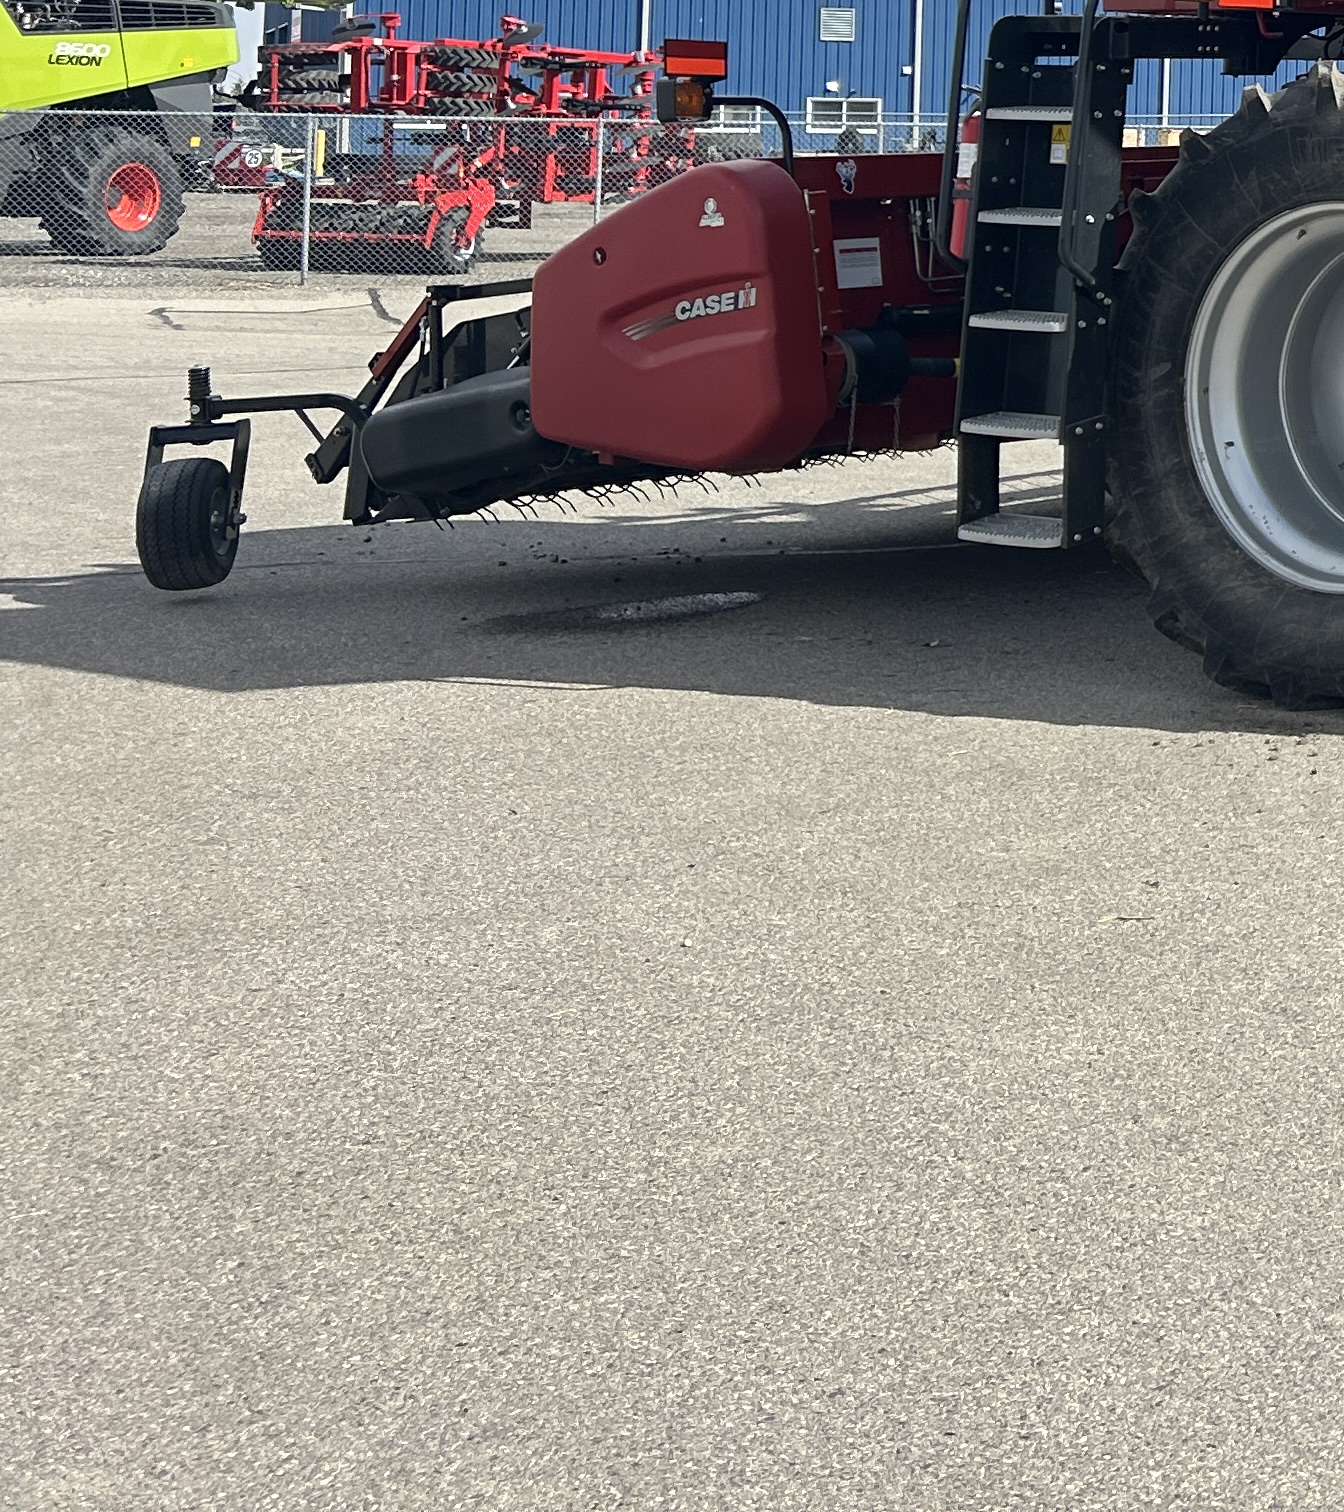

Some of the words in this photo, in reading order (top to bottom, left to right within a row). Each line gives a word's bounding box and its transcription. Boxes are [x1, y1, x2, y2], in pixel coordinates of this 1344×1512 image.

[55, 41, 112, 58] 8600
[47, 54, 102, 67] LEXION
[247, 152, 259, 165] 25
[675, 292, 735, 320] CASE
